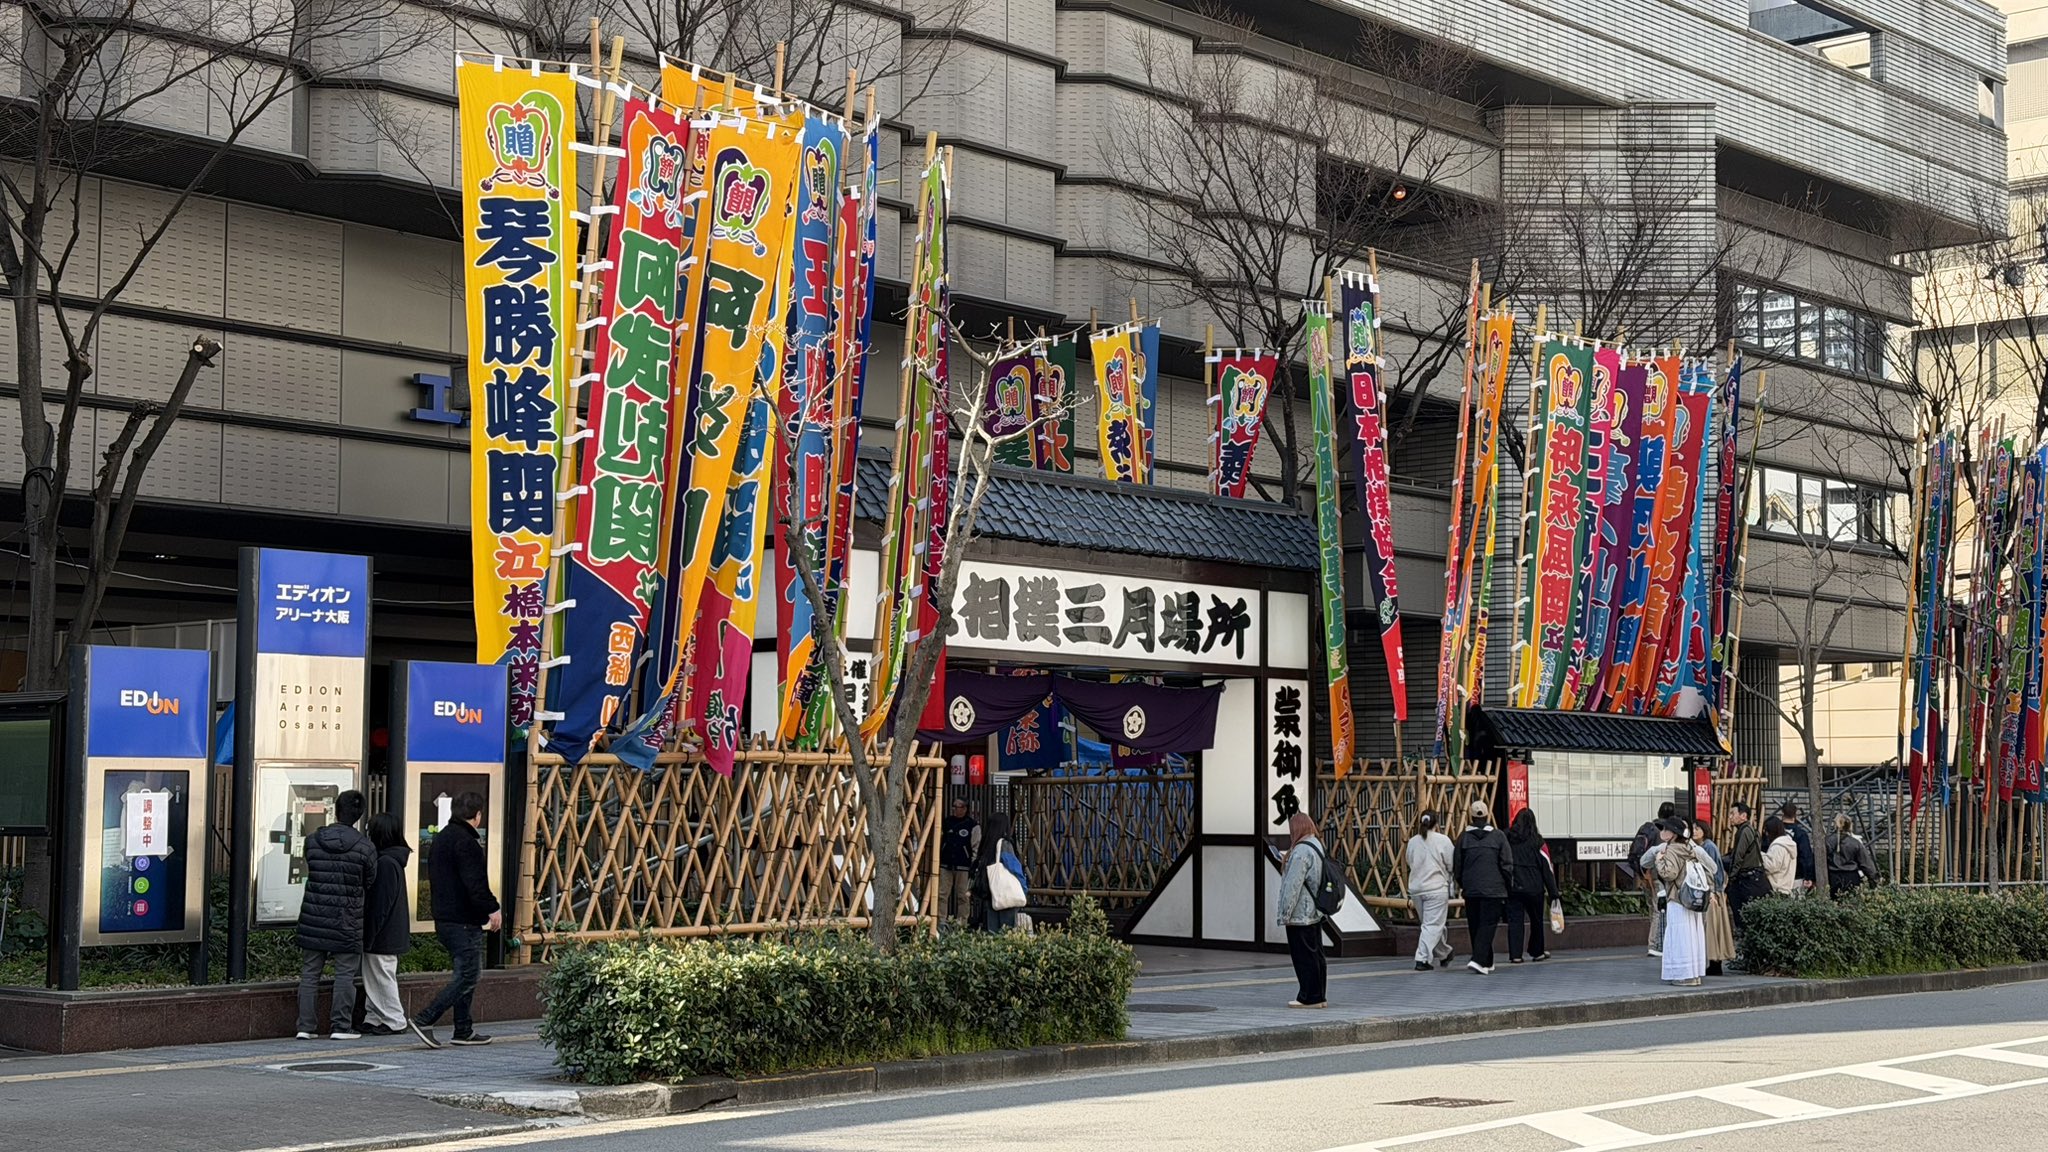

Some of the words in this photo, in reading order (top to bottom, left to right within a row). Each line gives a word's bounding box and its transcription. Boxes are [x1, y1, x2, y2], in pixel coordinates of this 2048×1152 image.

[476, 197, 558, 537] 琴勝峰関
[275, 584, 350, 603] エディオン
[275, 607, 350, 624] アリーナ大阪
[946, 571, 1251, 661] 相撲三月場所
[280, 684, 342, 696] EDION
[120, 689, 179, 715] EDION
[279, 702, 341, 713] Arena
[434, 700, 482, 724] EDION
[279, 719, 341, 730] Osaka
[141, 798, 154, 848] 調整中
[1606, 842, 1631, 858] 日本相
